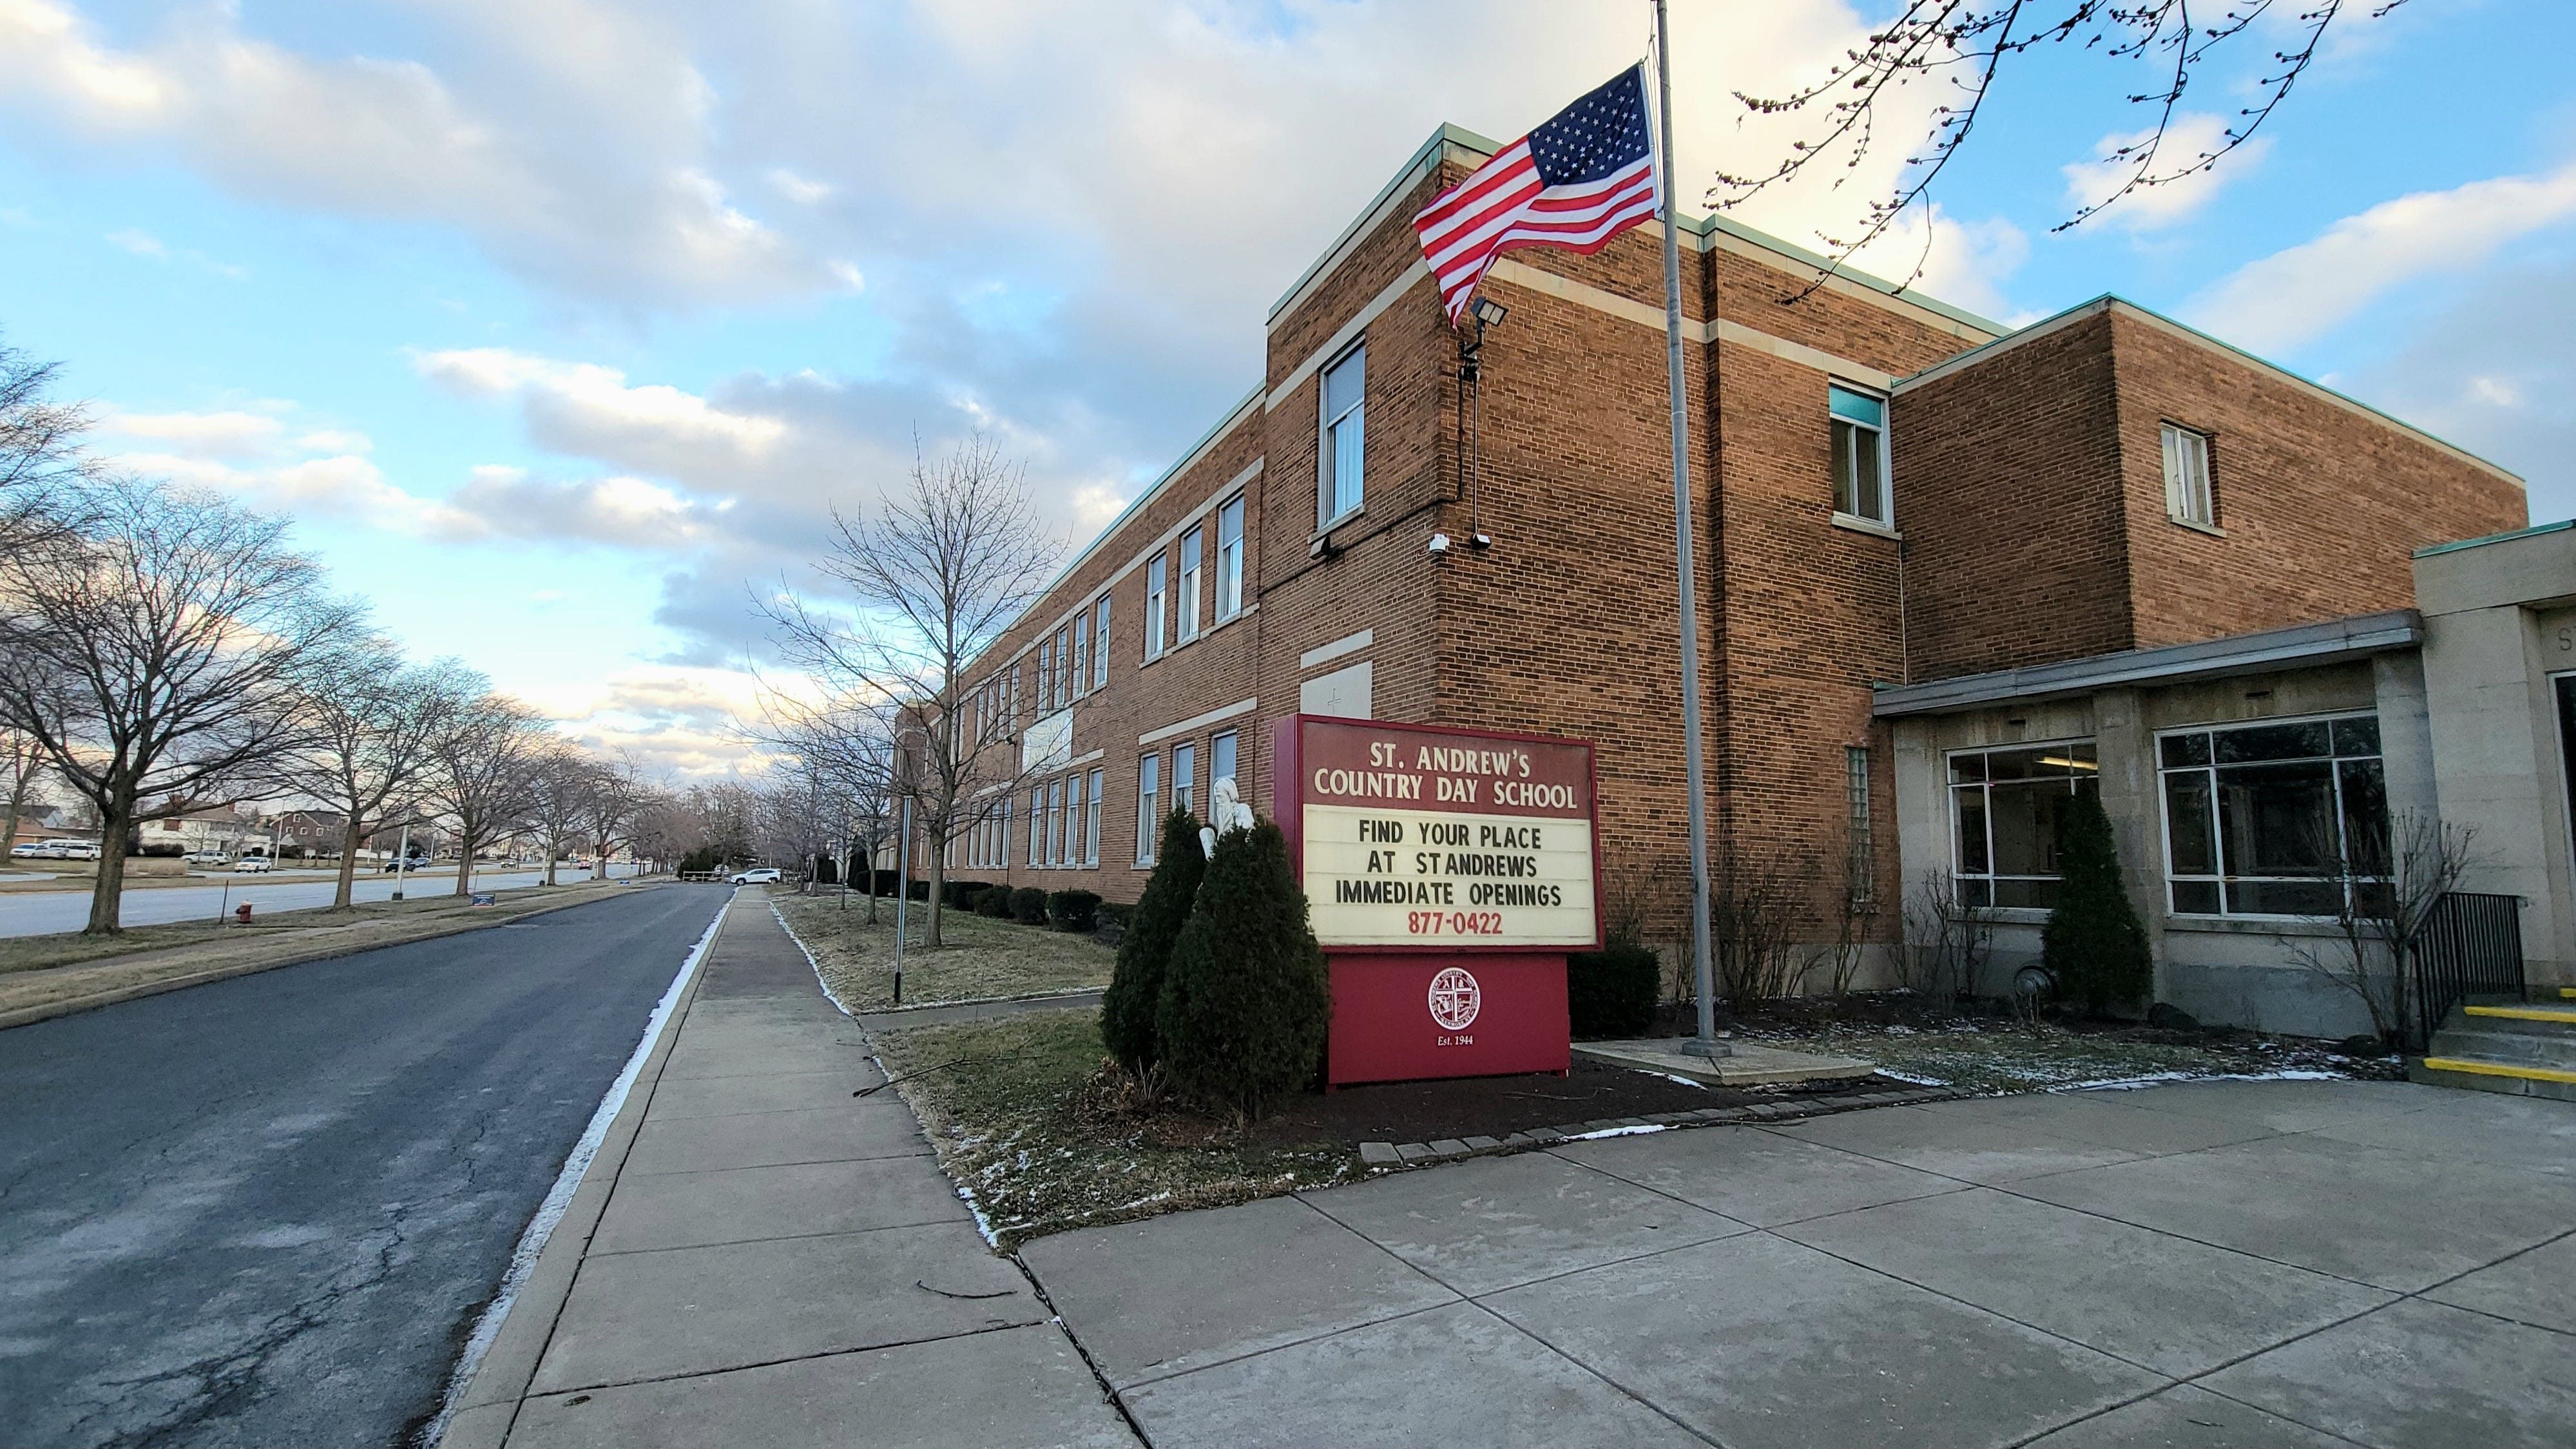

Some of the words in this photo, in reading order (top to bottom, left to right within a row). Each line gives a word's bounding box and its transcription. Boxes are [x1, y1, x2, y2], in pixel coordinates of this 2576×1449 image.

[2558, 628, 2576, 651] S
[1370, 742, 1405, 769] ST.
[1416, 745, 1530, 778] ANDREW'S
[1314, 768, 1423, 800] COUNTRY
[1437, 776, 1477, 803] DAY
[1494, 780, 1577, 809] SCHOOL
[1360, 819, 1403, 843] FIND
[1418, 822, 1470, 846] YOUR
[1481, 825, 1541, 849] PLACE
[1367, 850, 1396, 873] AT
[1336, 880, 1454, 905] IMMEDIATE
[1469, 883, 1561, 907] OPENINGS
[1408, 911, 1503, 935] 877-0422
[1437, 1036, 1452, 1046] Est.
[1455, 1035, 1474, 1045] 1944
